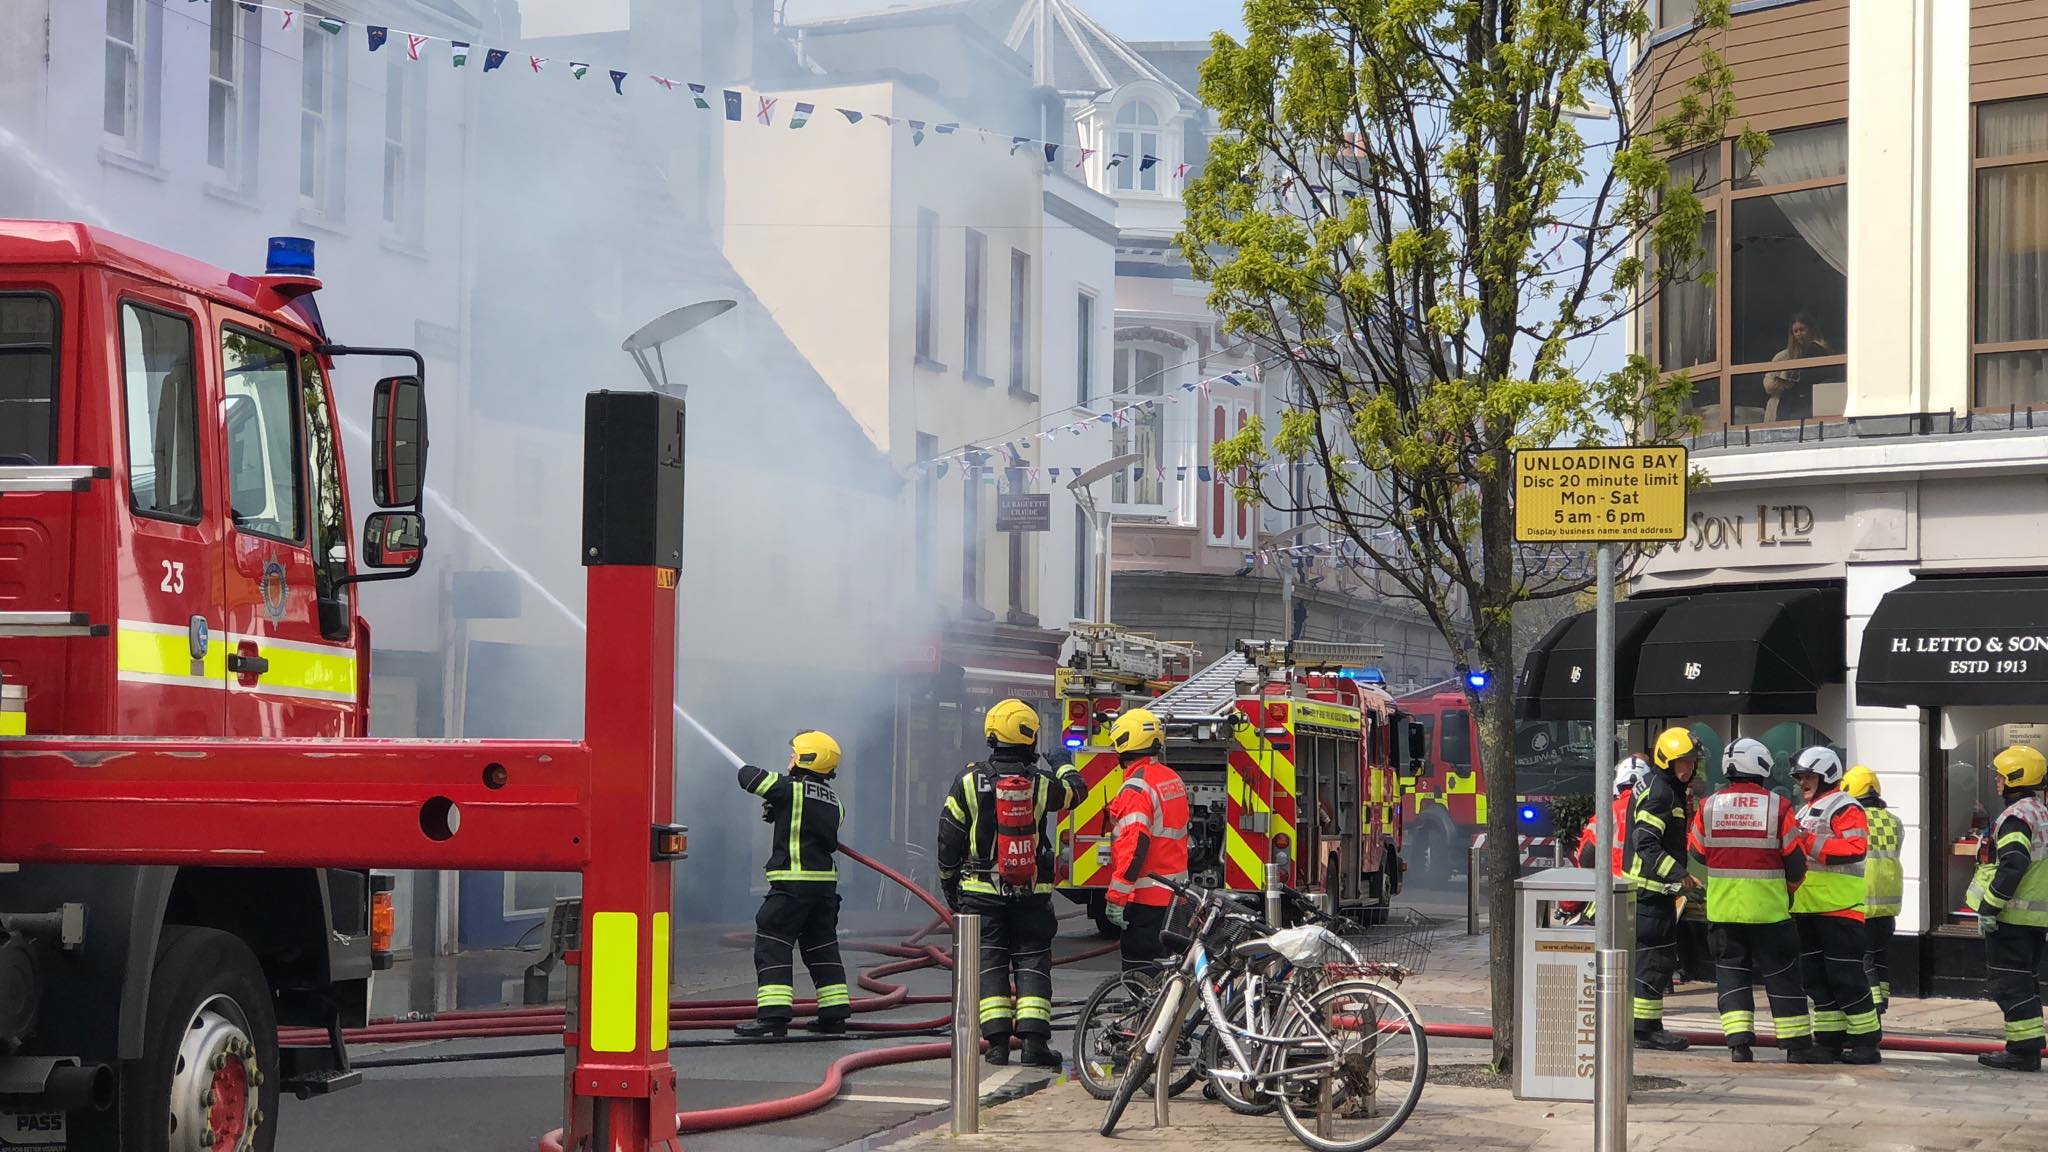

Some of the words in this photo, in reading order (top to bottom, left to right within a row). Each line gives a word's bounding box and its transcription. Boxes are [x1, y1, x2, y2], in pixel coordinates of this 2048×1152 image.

[1524, 455, 1635, 471] UNLOADING
[1642, 454, 1678, 469] BAY
[1523, 475, 1554, 488] Disc
[1560, 475, 1580, 487] 20
[1586, 474, 1639, 487] minute
[1644, 473, 1678, 486] limit
[1561, 491, 1596, 505] Mon
[1610, 490, 1639, 504] Sat
[1527, 527, 1557, 537] Display
[1560, 527, 1595, 535] business
[1640, 526, 1673, 534] address
[1690, 511, 1744, 552] SON
[160, 559, 185, 595] 23
[1891, 637, 1911, 652] H.
[1916, 636, 1982, 652] LETTO
[1986, 636, 2003, 652] &
[1949, 660, 1990, 674] ESTD
[1996, 659, 2027, 673] 1913
[807, 783, 839, 803] FIRE
[1724, 796, 1759, 808] IRE
[1008, 840, 1032, 855] AIR
[1577, 974, 1596, 1046] Helier
[1577, 1053, 1595, 1080] St
